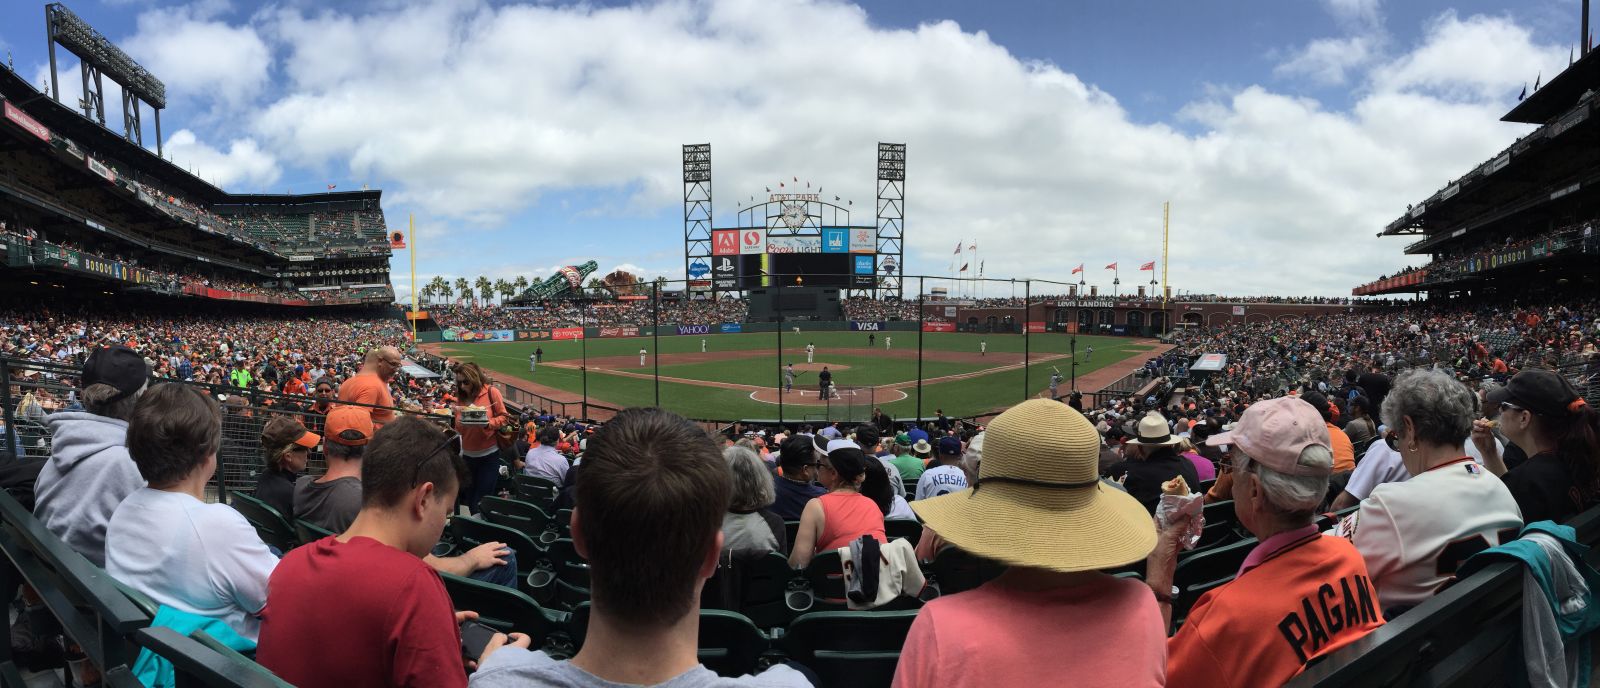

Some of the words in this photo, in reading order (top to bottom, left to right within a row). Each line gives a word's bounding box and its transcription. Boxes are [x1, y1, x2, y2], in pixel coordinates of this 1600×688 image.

[770, 194, 791, 203] AT&T
[796, 193, 819, 202] PARK
[678, 325, 710, 334] YAHOO!
[857, 322, 879, 330] VISA
[1278, 574, 1378, 664] PAGAN
